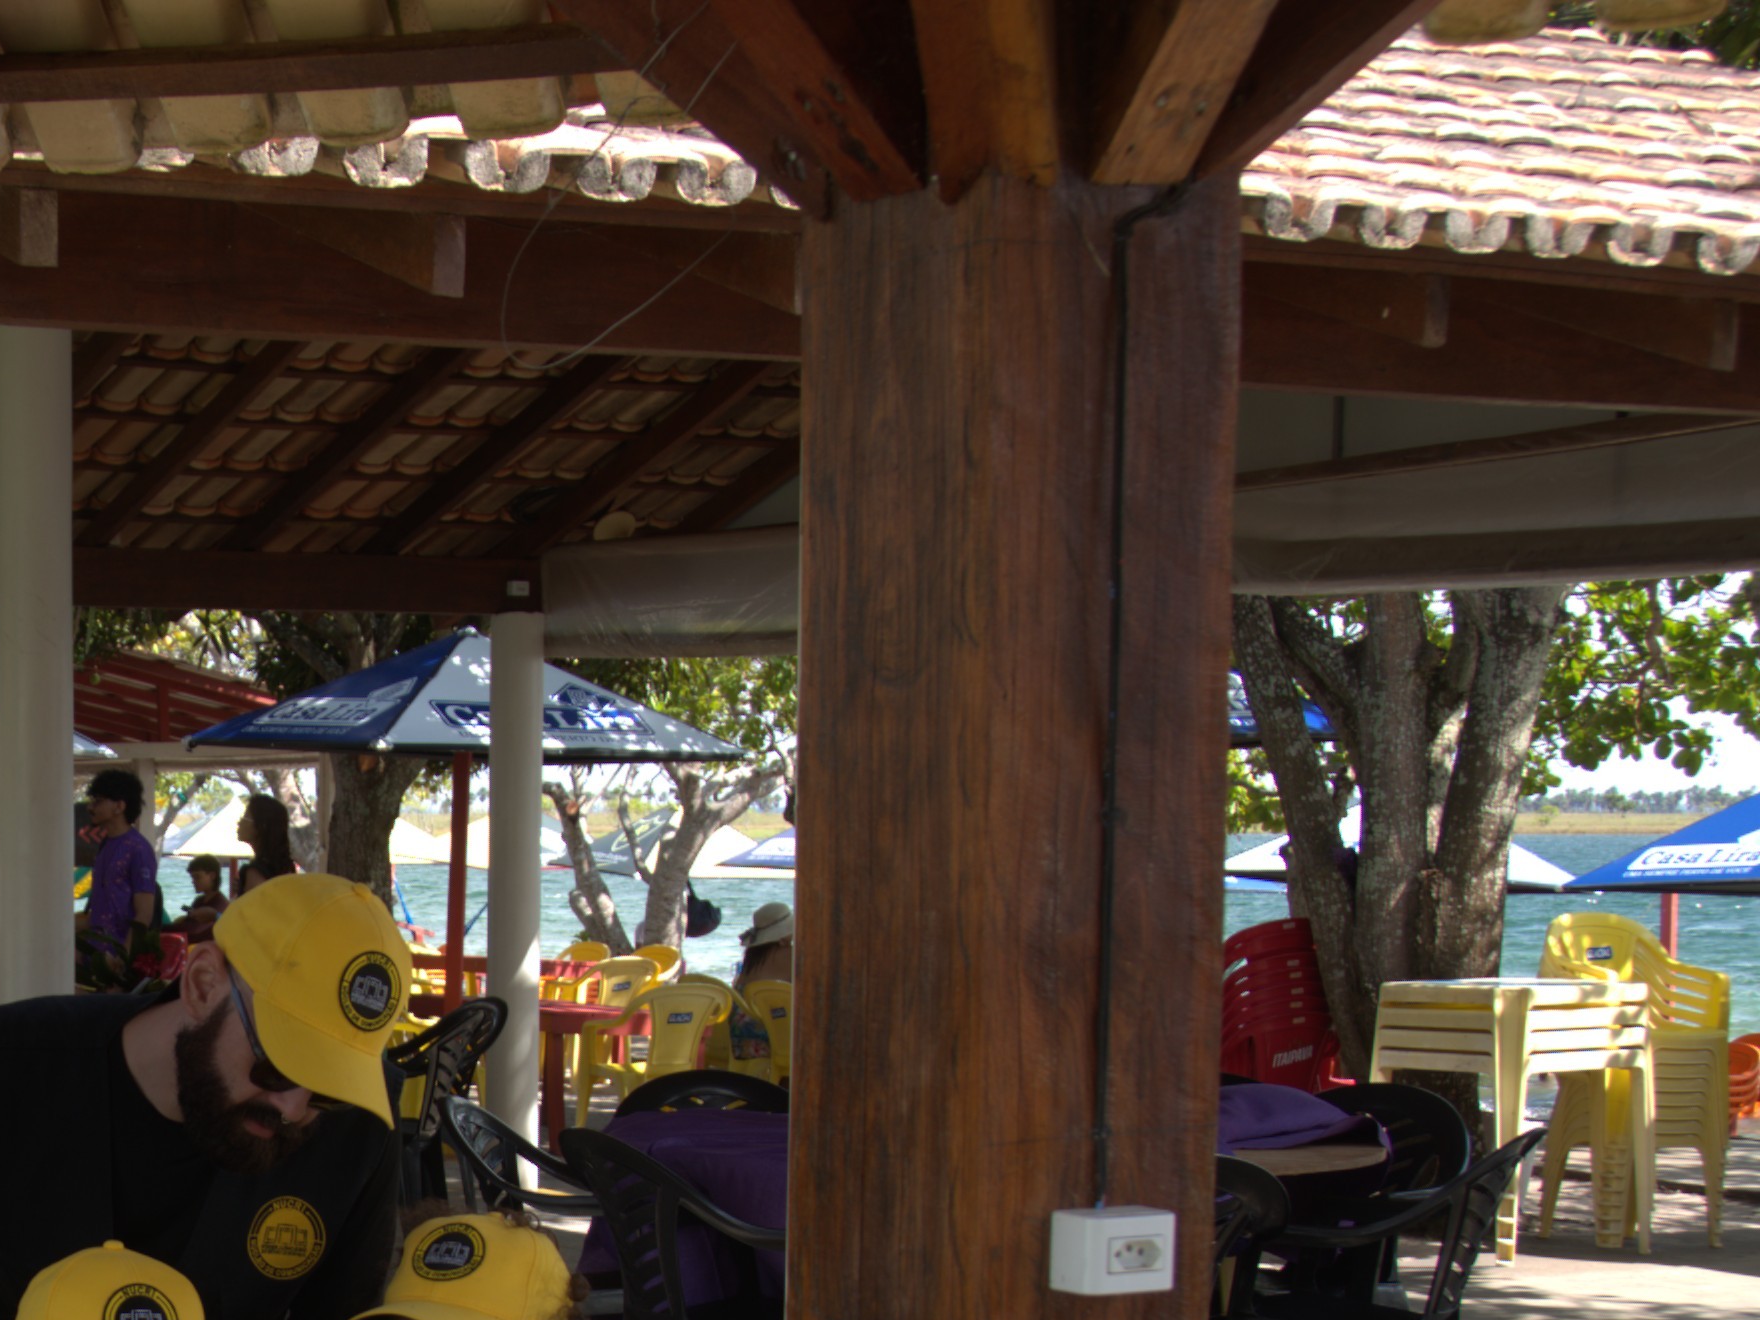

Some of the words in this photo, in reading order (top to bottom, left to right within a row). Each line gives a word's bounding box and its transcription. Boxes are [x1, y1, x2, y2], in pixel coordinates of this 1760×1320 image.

[1641, 850, 1704, 866] Casa
[1705, 847, 1760, 863] Lira
[1272, 1045, 1313, 1068] ITAIPAVA
